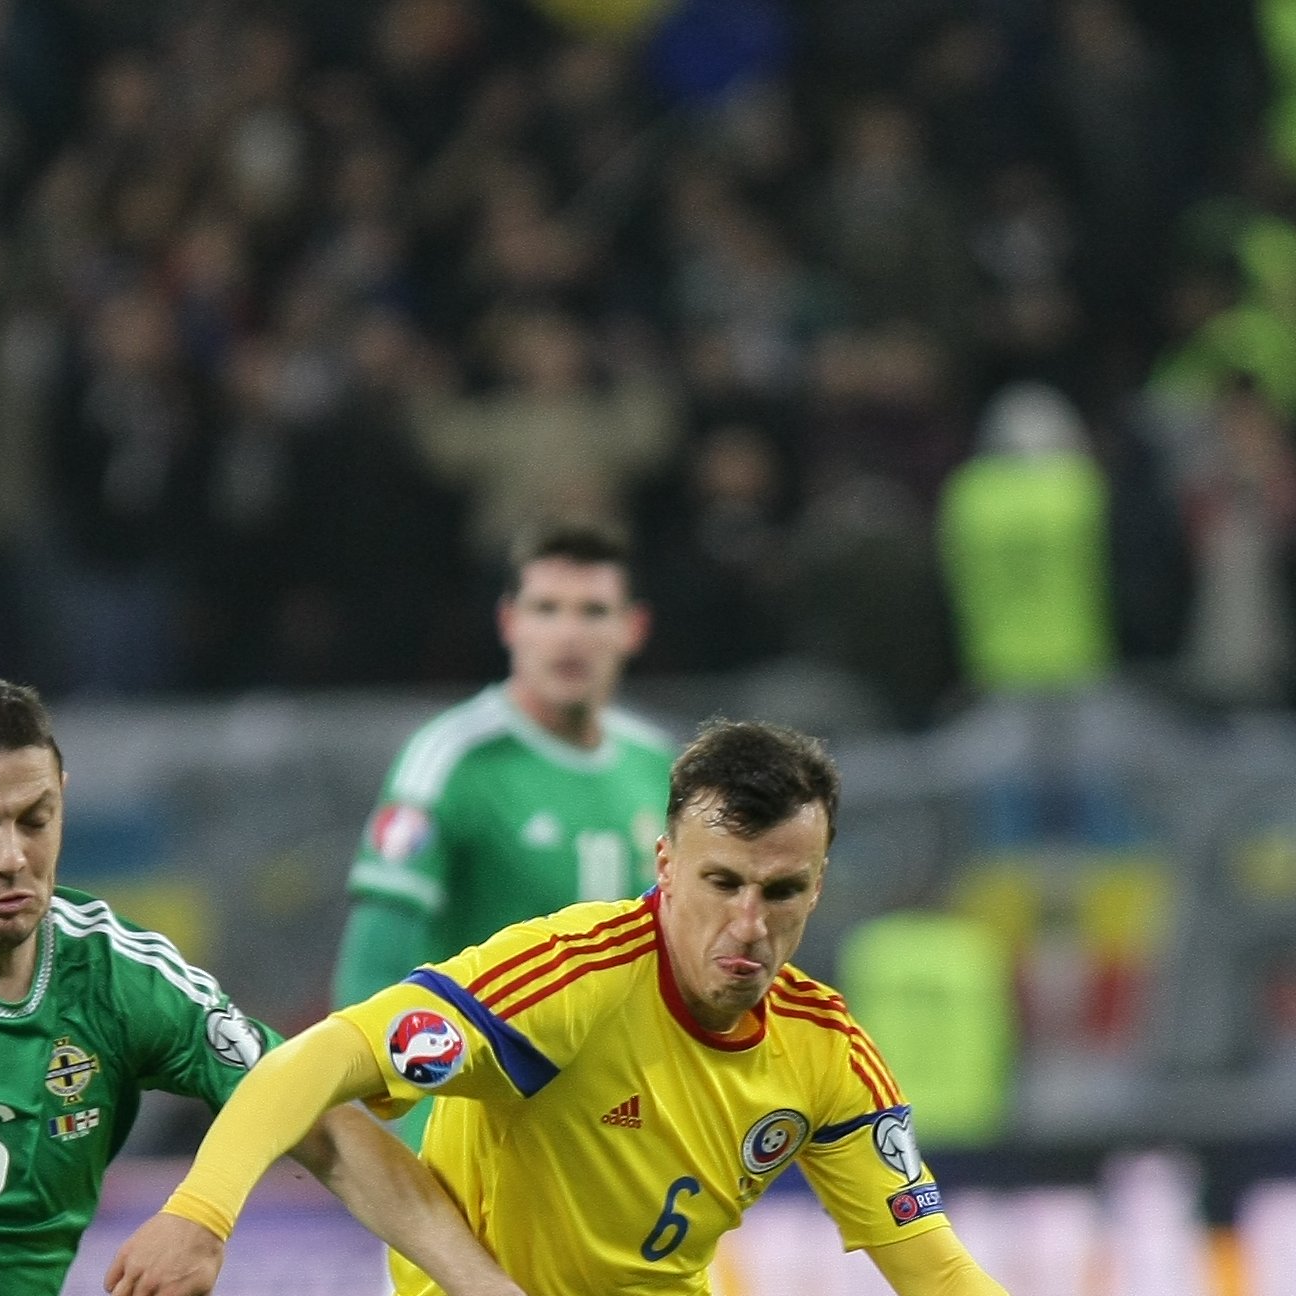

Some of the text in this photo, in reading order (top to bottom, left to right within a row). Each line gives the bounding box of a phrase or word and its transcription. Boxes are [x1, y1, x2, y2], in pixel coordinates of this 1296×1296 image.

[601, 1114, 642, 1129] adidas
[916, 1191, 942, 1208] RES
[641, 1176, 700, 1262] 6
